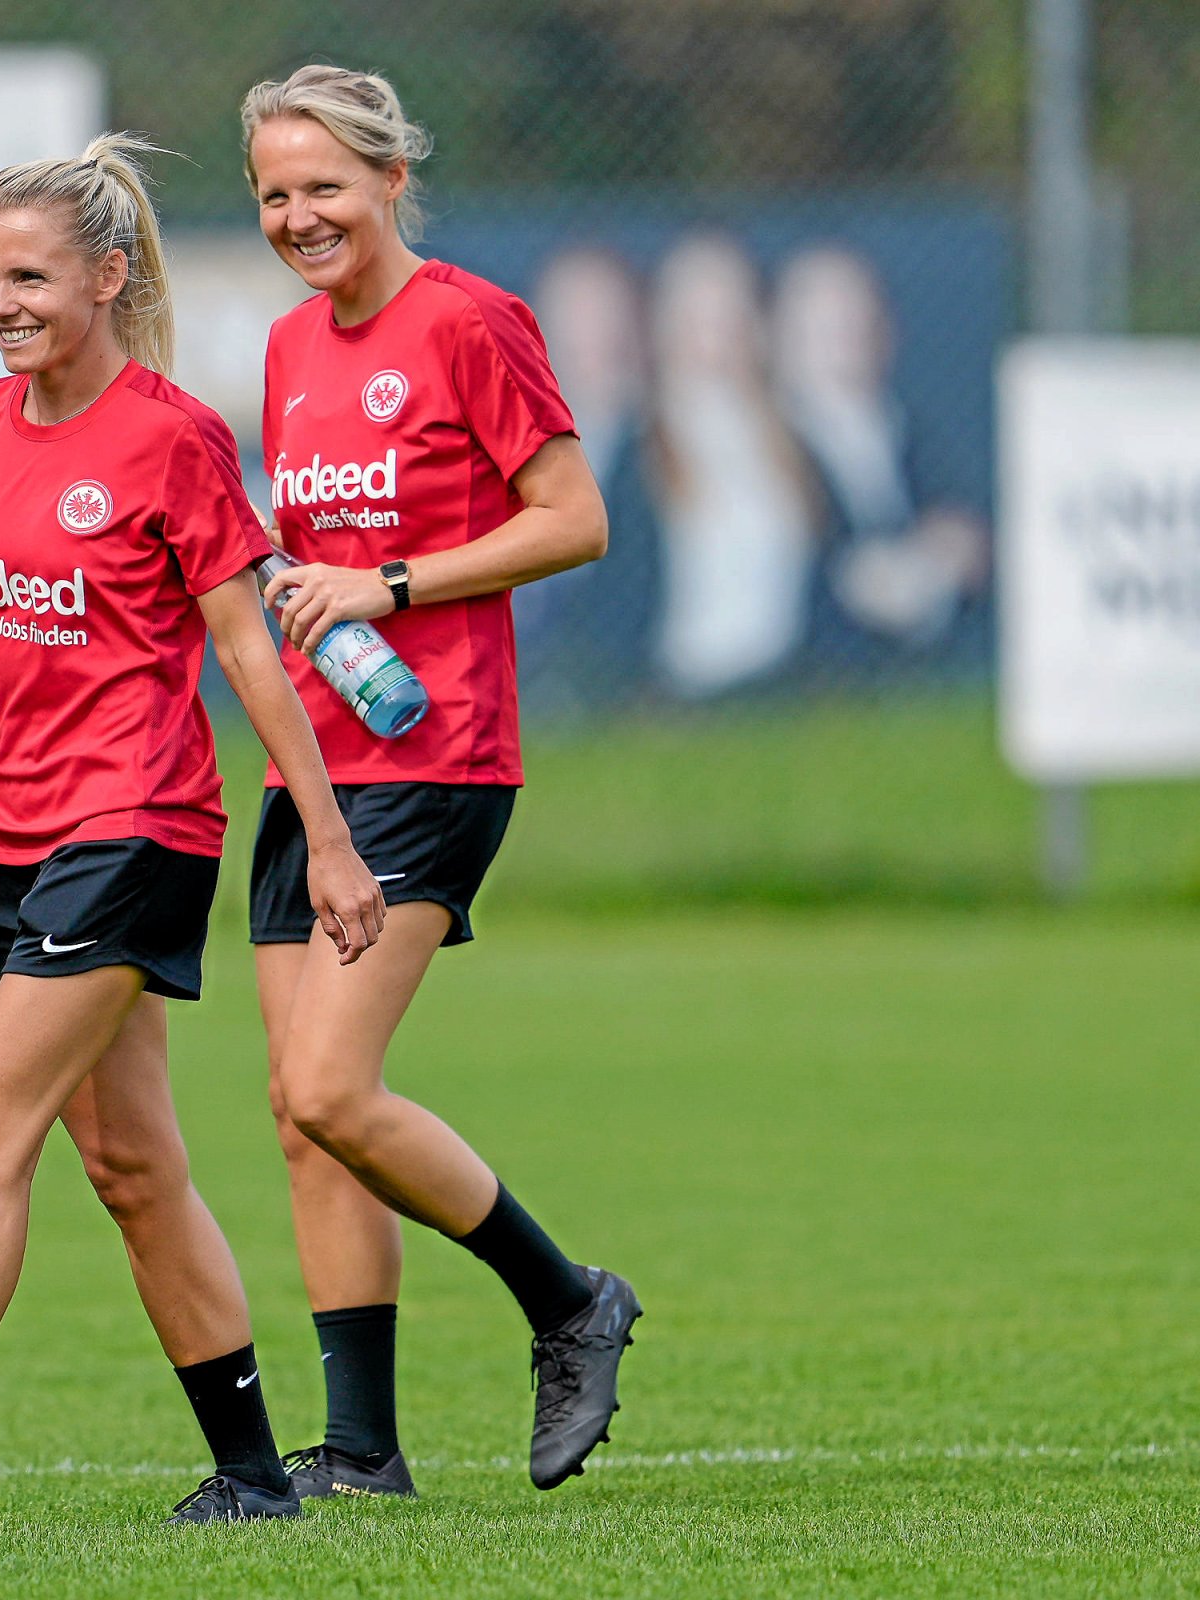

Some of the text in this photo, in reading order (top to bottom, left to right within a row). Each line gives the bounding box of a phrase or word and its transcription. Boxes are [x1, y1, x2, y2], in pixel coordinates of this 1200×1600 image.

[271, 448, 397, 510] indeed
[309, 507, 399, 531] Jobs finden
[29, 621, 87, 646] finden
